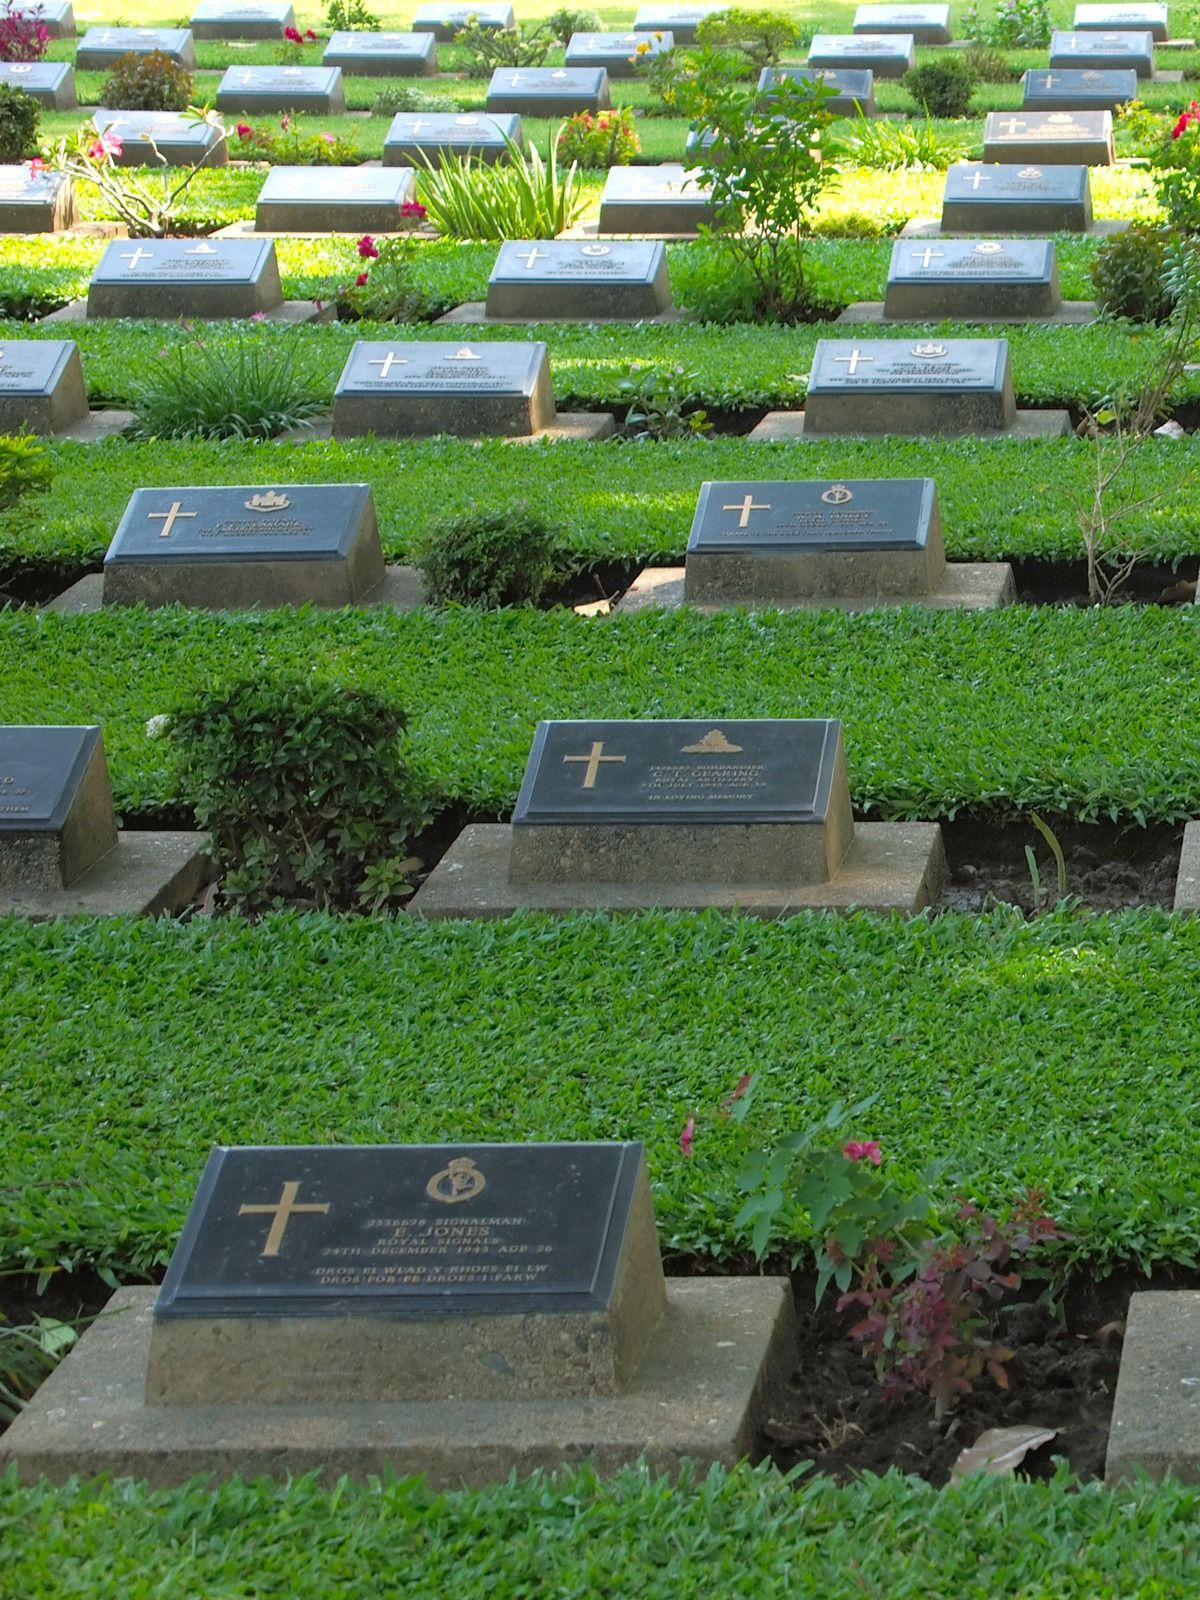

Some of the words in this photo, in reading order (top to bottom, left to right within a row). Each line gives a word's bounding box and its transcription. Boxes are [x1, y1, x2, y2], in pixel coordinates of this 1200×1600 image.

[434, 1217, 523, 1227] SIGNALMAN
[393, 1226, 413, 1238] E.
[419, 1226, 491, 1238] JONES
[377, 1238, 428, 1246] ROYAL
[437, 1237, 500, 1245] SIGNALS
[322, 1247, 361, 1256] 24TH
[370, 1246, 447, 1255] DECEMBER
[497, 1245, 528, 1253] AGE
[313, 1266, 356, 1275] DROS
[320, 1275, 361, 1284] DROS
